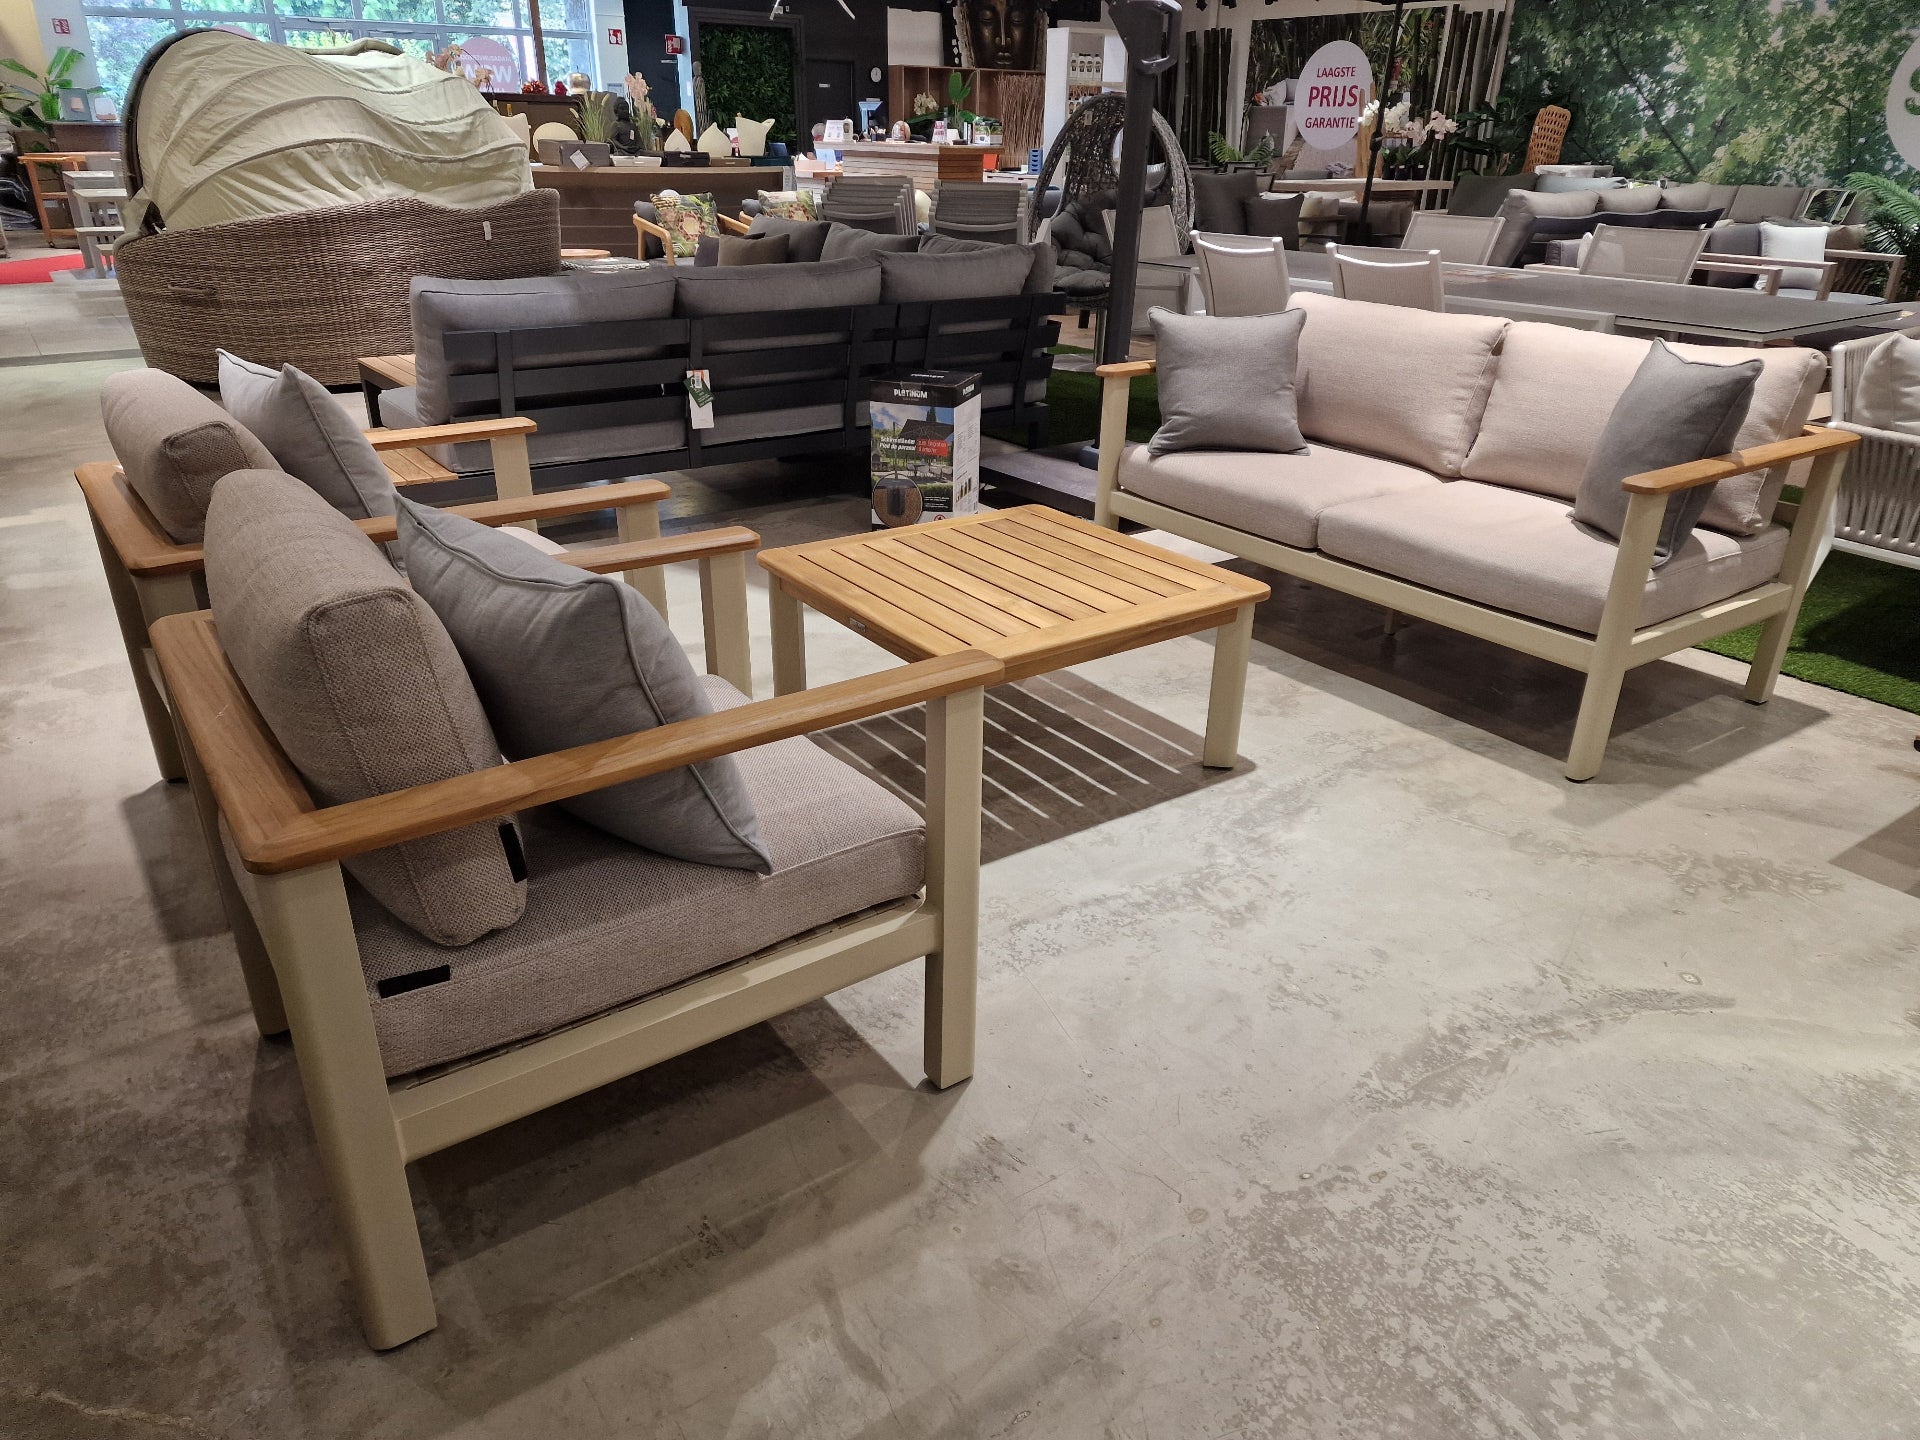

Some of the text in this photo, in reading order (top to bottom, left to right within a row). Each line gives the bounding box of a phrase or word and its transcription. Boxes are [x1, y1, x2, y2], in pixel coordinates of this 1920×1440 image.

[1317, 66, 1356, 78] LAAGSTE
[1308, 85, 1358, 107] PRIJS
[1305, 117, 1355, 129] GARANTIE
